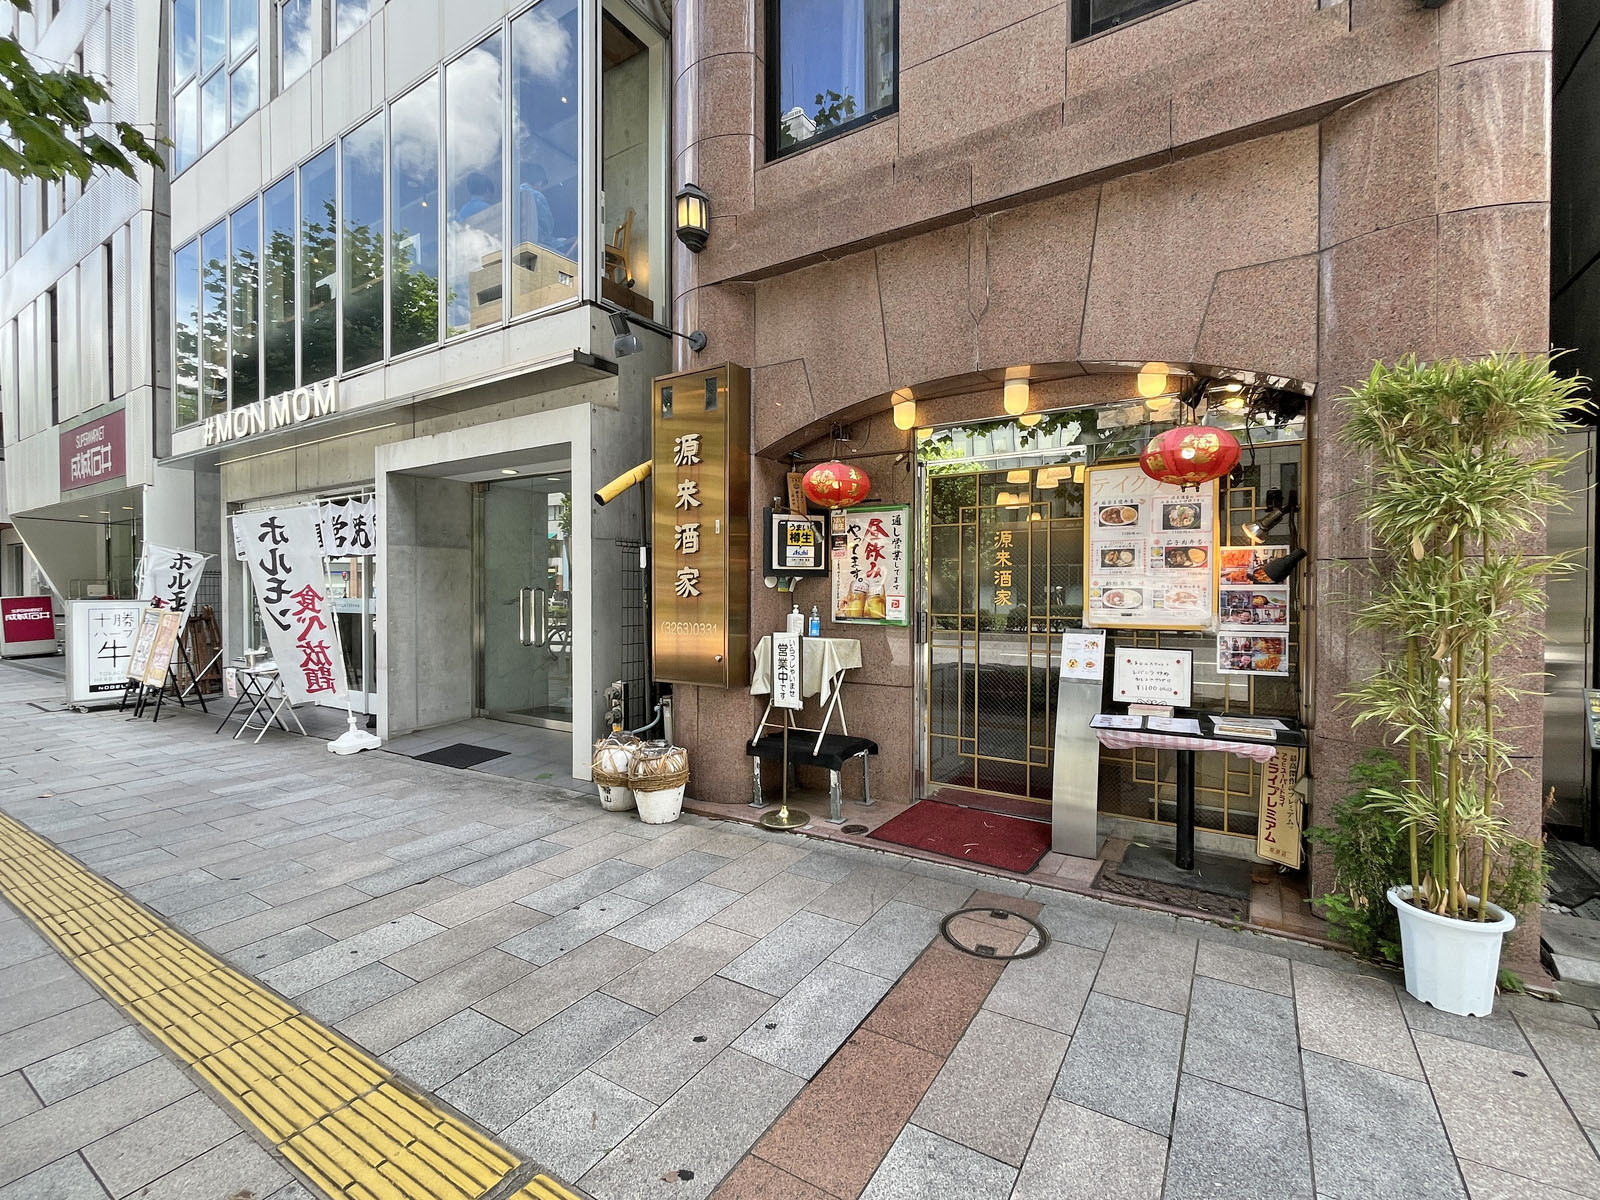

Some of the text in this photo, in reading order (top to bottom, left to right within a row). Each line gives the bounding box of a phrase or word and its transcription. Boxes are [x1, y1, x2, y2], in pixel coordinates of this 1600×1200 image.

[71, 442, 112, 482] 成城石井
[673, 433, 701, 598] 源来酒家
[789, 532, 812, 543] 樽生
[167, 552, 193, 618] ホルモ
[993, 530, 1014, 606] 源来酒家
[93, 612, 135, 628] 十勝
[97, 640, 132, 668] 牛
[777, 643, 788, 700] 営業中です
